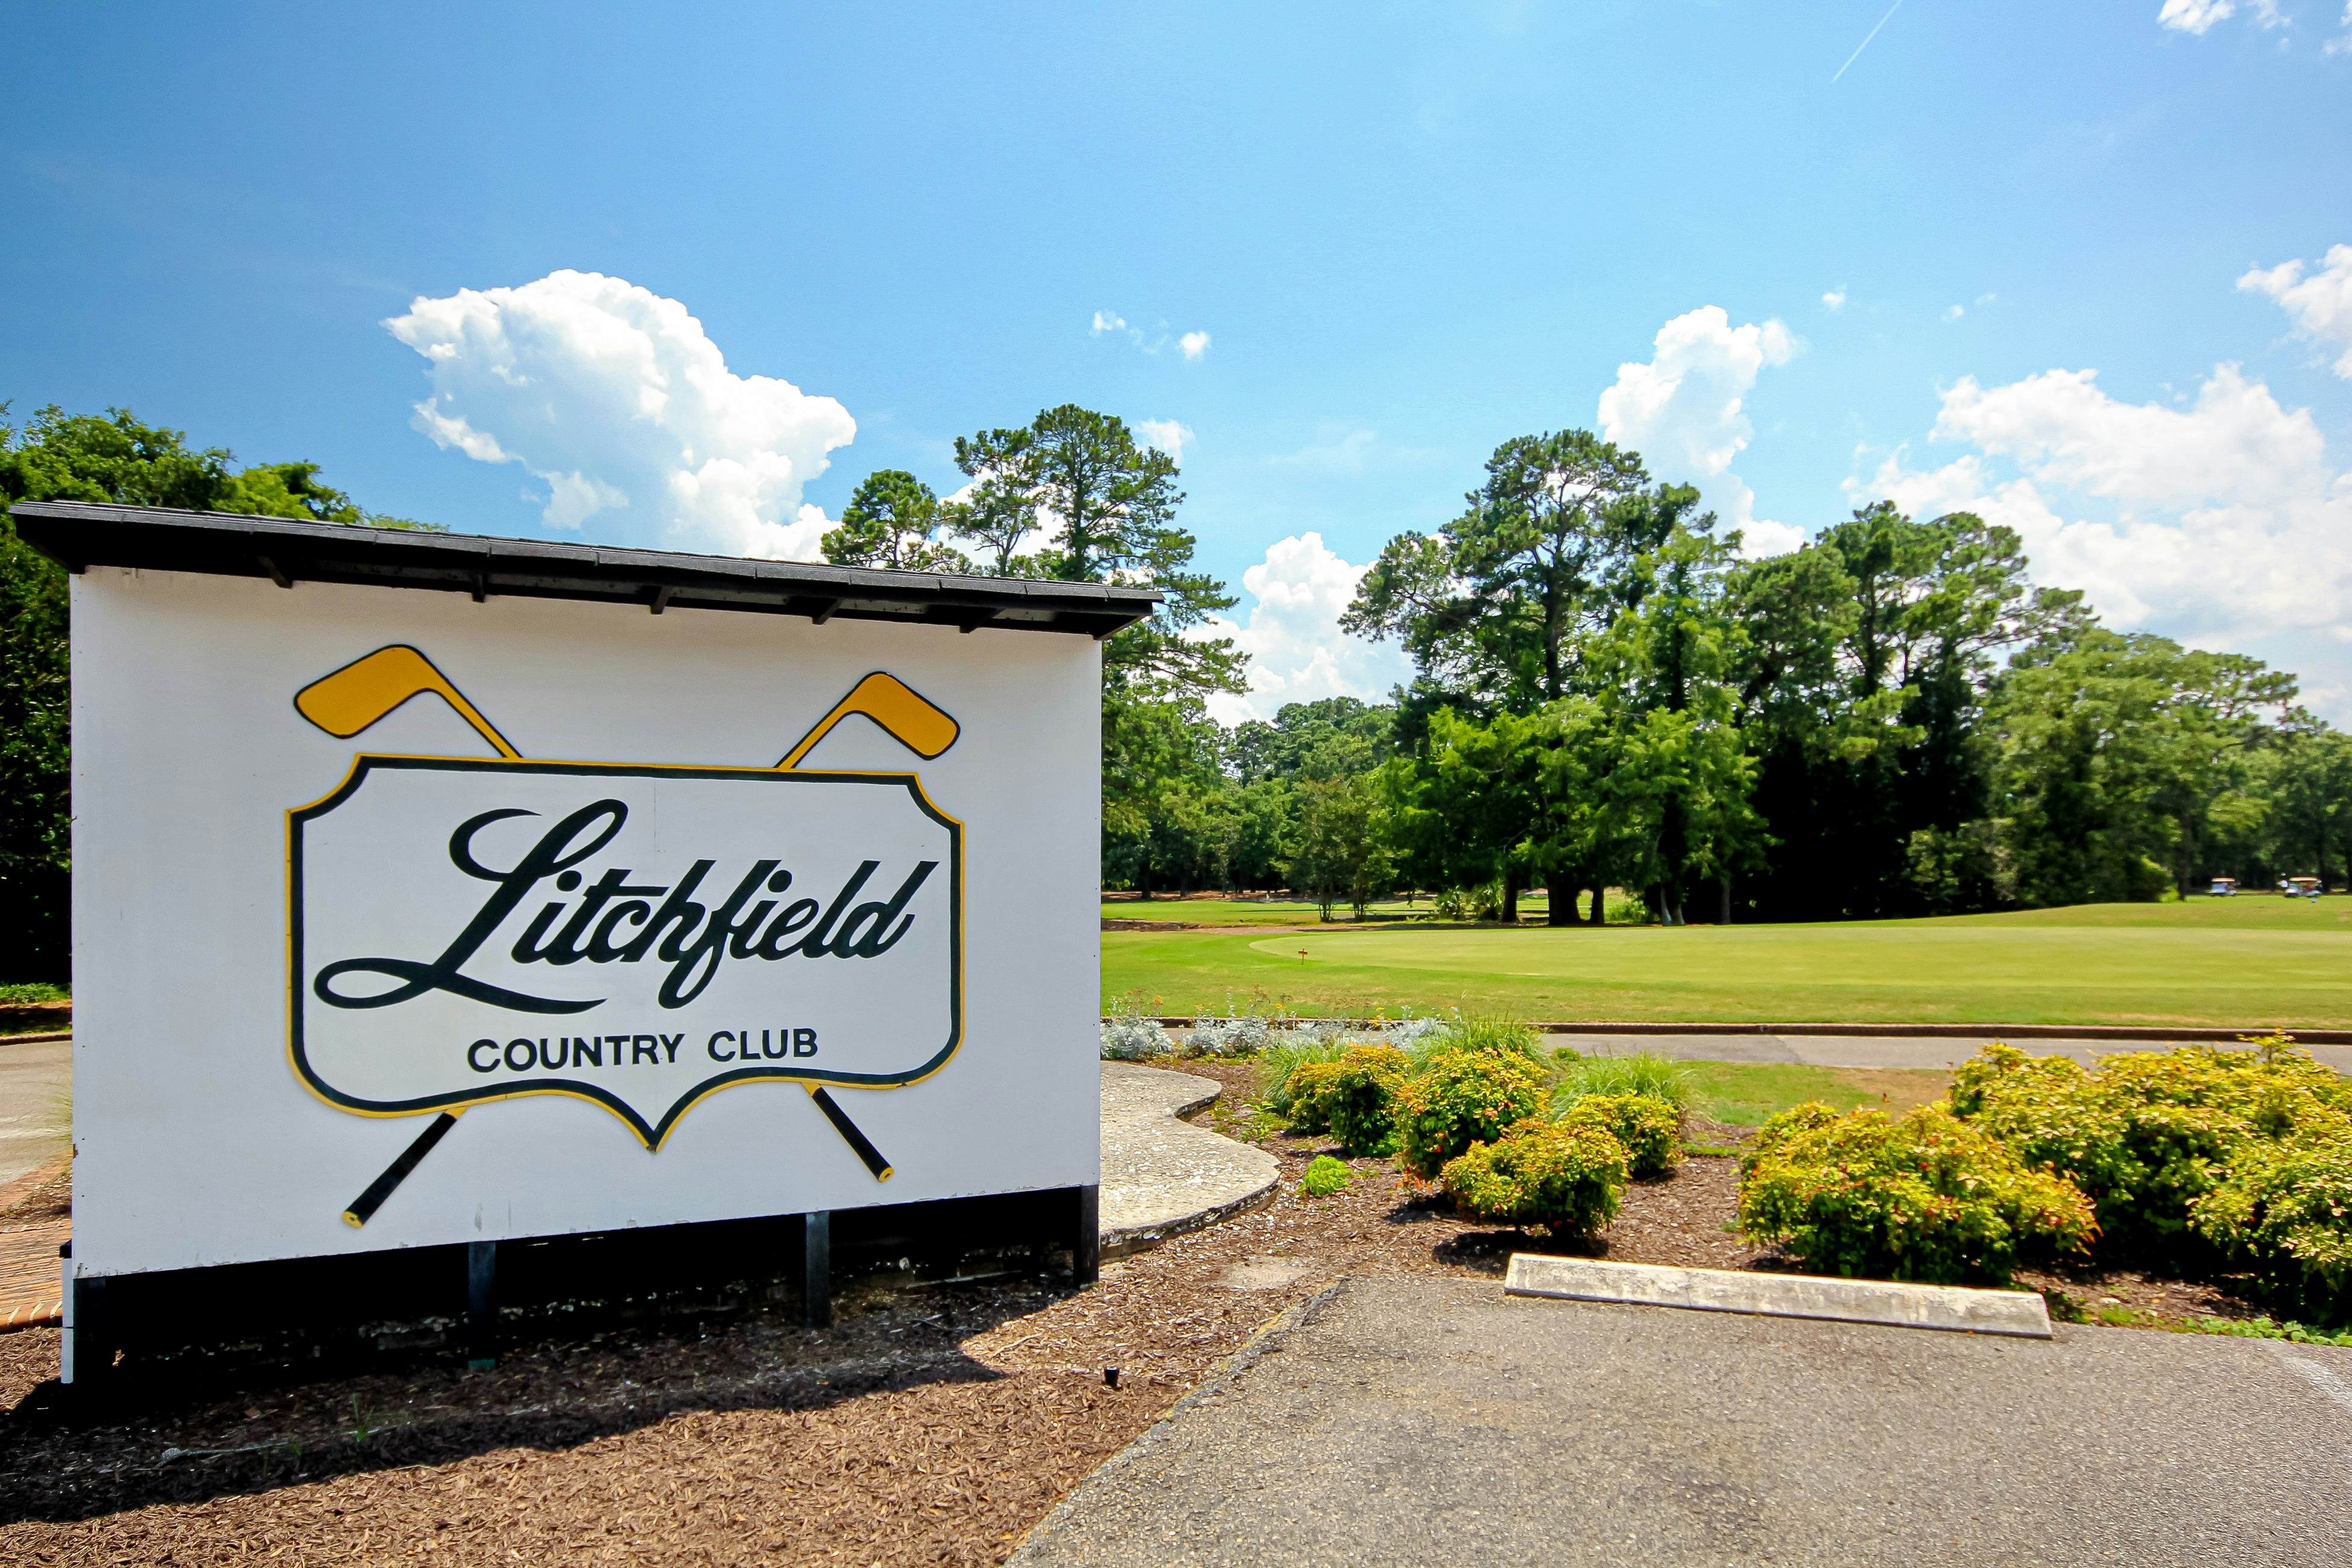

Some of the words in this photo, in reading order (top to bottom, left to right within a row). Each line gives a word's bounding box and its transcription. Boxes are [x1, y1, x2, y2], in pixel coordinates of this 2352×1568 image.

[314, 798, 941, 1015] Litchfield
[467, 1032, 686, 1073] COUNTRY
[707, 1027, 819, 1062] CLUB
